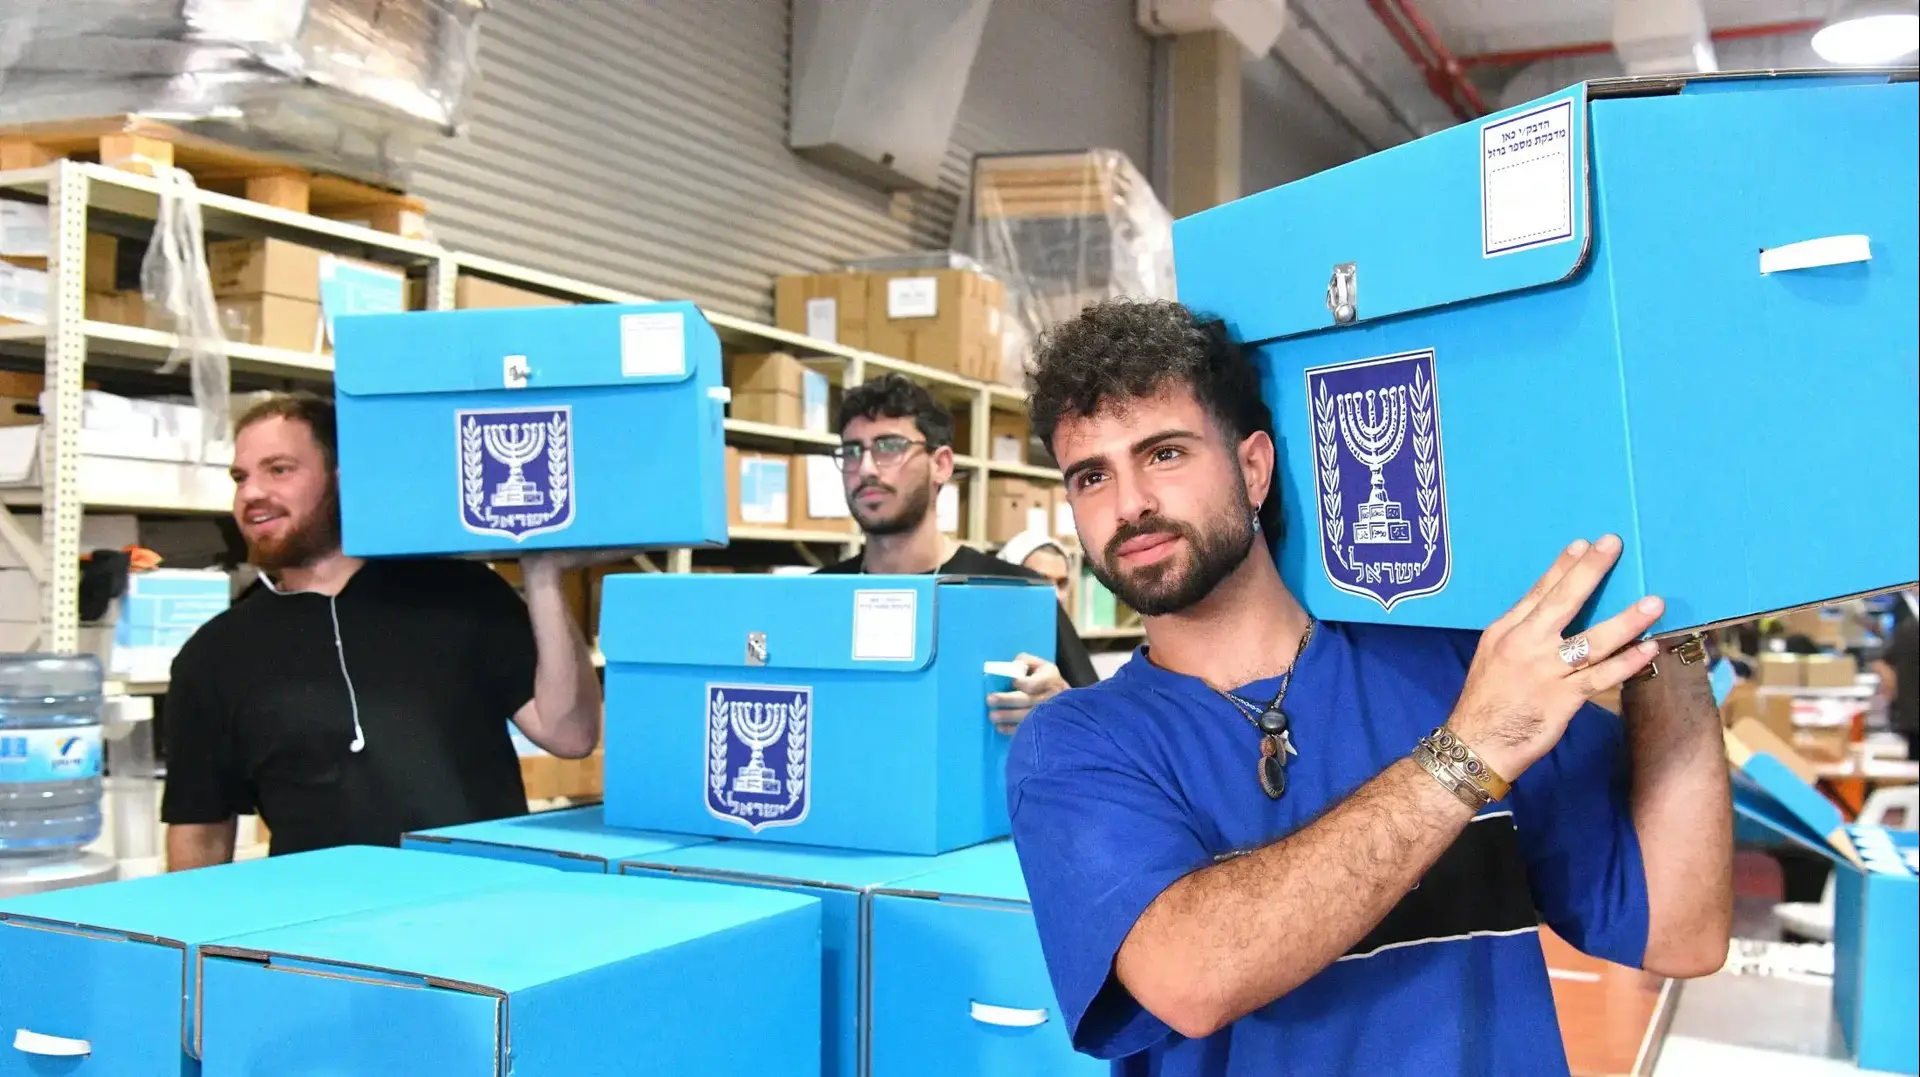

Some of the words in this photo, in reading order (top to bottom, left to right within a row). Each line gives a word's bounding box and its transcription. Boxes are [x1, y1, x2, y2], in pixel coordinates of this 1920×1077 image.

[1518, 120, 1550, 137] הדבק/י
[1501, 131, 1516, 143] כאן
[1534, 129, 1566, 145] מדבקת
[1487, 147, 1507, 159] ברזל
[1508, 139, 1533, 152] מספר
[485, 506, 550, 528] ישראל
[1348, 545, 1421, 584] ישראל
[727, 791, 786, 817] ישראל
